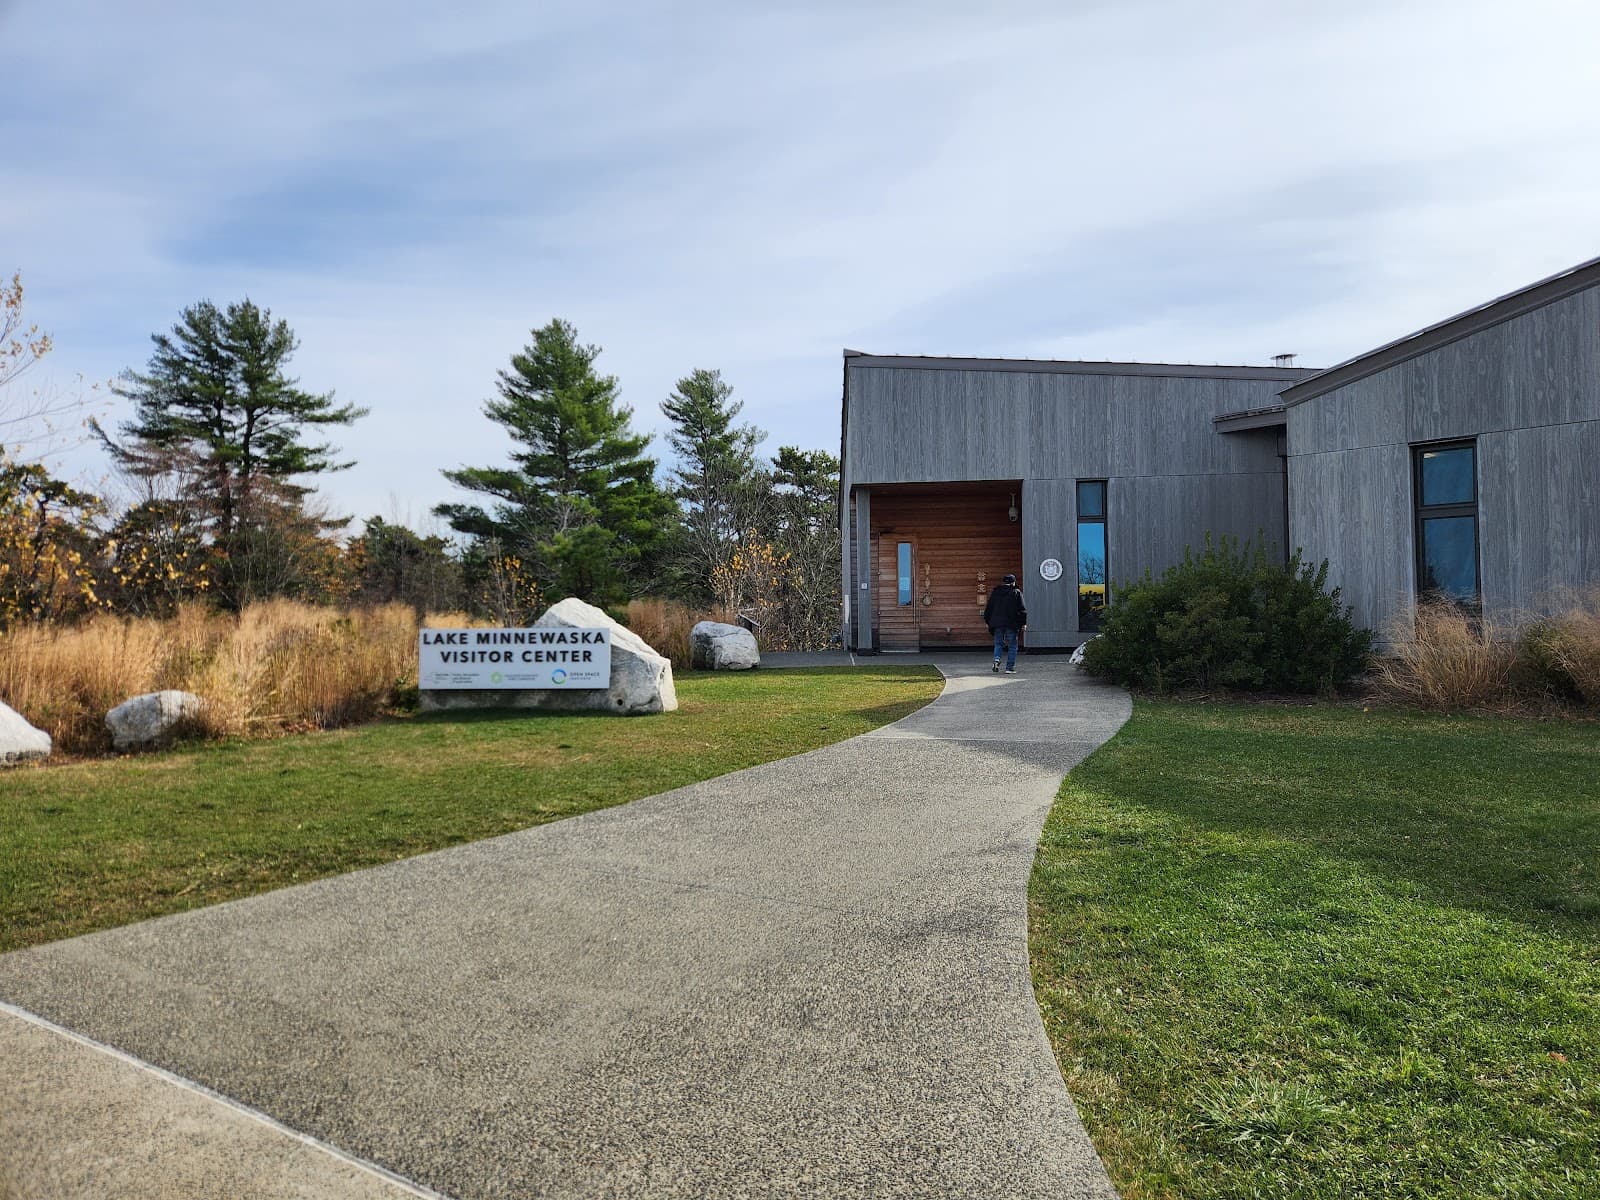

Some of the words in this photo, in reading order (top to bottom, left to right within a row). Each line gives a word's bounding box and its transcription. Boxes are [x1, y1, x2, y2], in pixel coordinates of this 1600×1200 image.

[423, 633, 468, 645] LAKE
[476, 632, 604, 644] MINNEWASKA
[440, 651, 513, 663] VISITOR
[521, 650, 592, 663] CENTER
